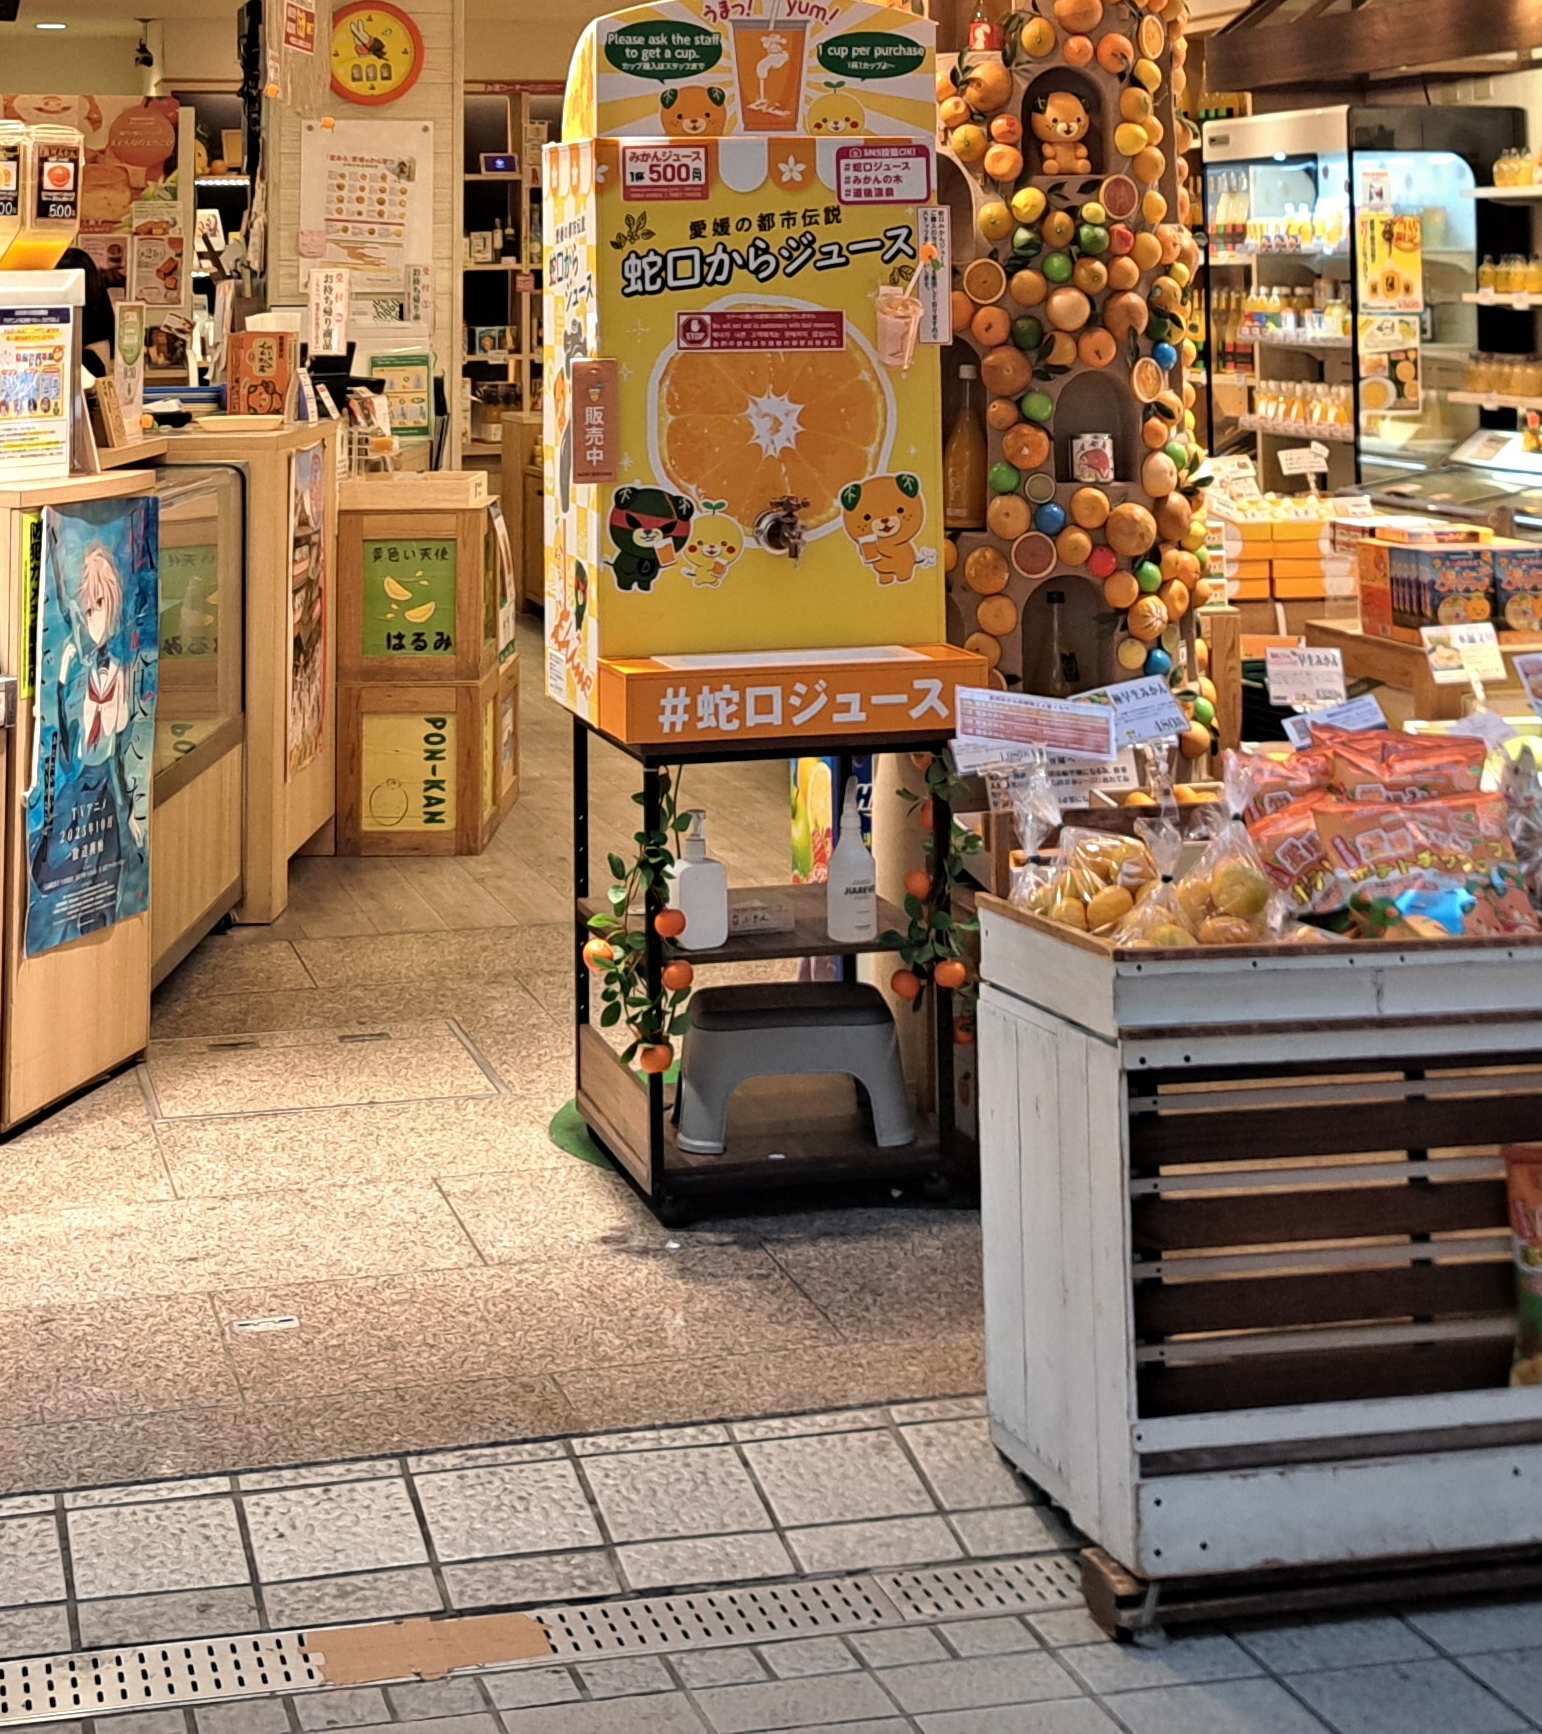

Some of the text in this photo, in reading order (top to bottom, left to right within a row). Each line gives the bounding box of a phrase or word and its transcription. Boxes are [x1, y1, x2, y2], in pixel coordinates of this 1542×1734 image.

[786, 0, 840, 26] yum!
[607, 33, 721, 46] Please ask the staff
[625, 48, 700, 61] to get a cup.
[827, 46, 849, 59] cup
[851, 46, 870, 60] per
[873, 45, 926, 59] purchase
[628, 150, 702, 163] みかんジュース
[843, 161, 912, 173] #蛇口ジュース
[648, 162, 702, 183] 500円
[843, 174, 904, 185] #みかんの木
[843, 187, 895, 198] #道後温泉
[688, 206, 843, 241] 愛媛の都市伝説
[621, 226, 917, 297] 蛇口からジュース
[322, 273, 334, 351] お持ち帰り商品
[685, 331, 706, 341] STOP
[584, 405, 606, 466] 販売中
[385, 631, 452, 652] はるみ
[657, 677, 951, 734] #蛇口ジュース
[422, 716, 447, 825] PON-KAN
[71, 798, 107, 821] TVアニメ
[59, 815, 114, 844] 2025年10月
[71, 839, 105, 862] 放送開始
